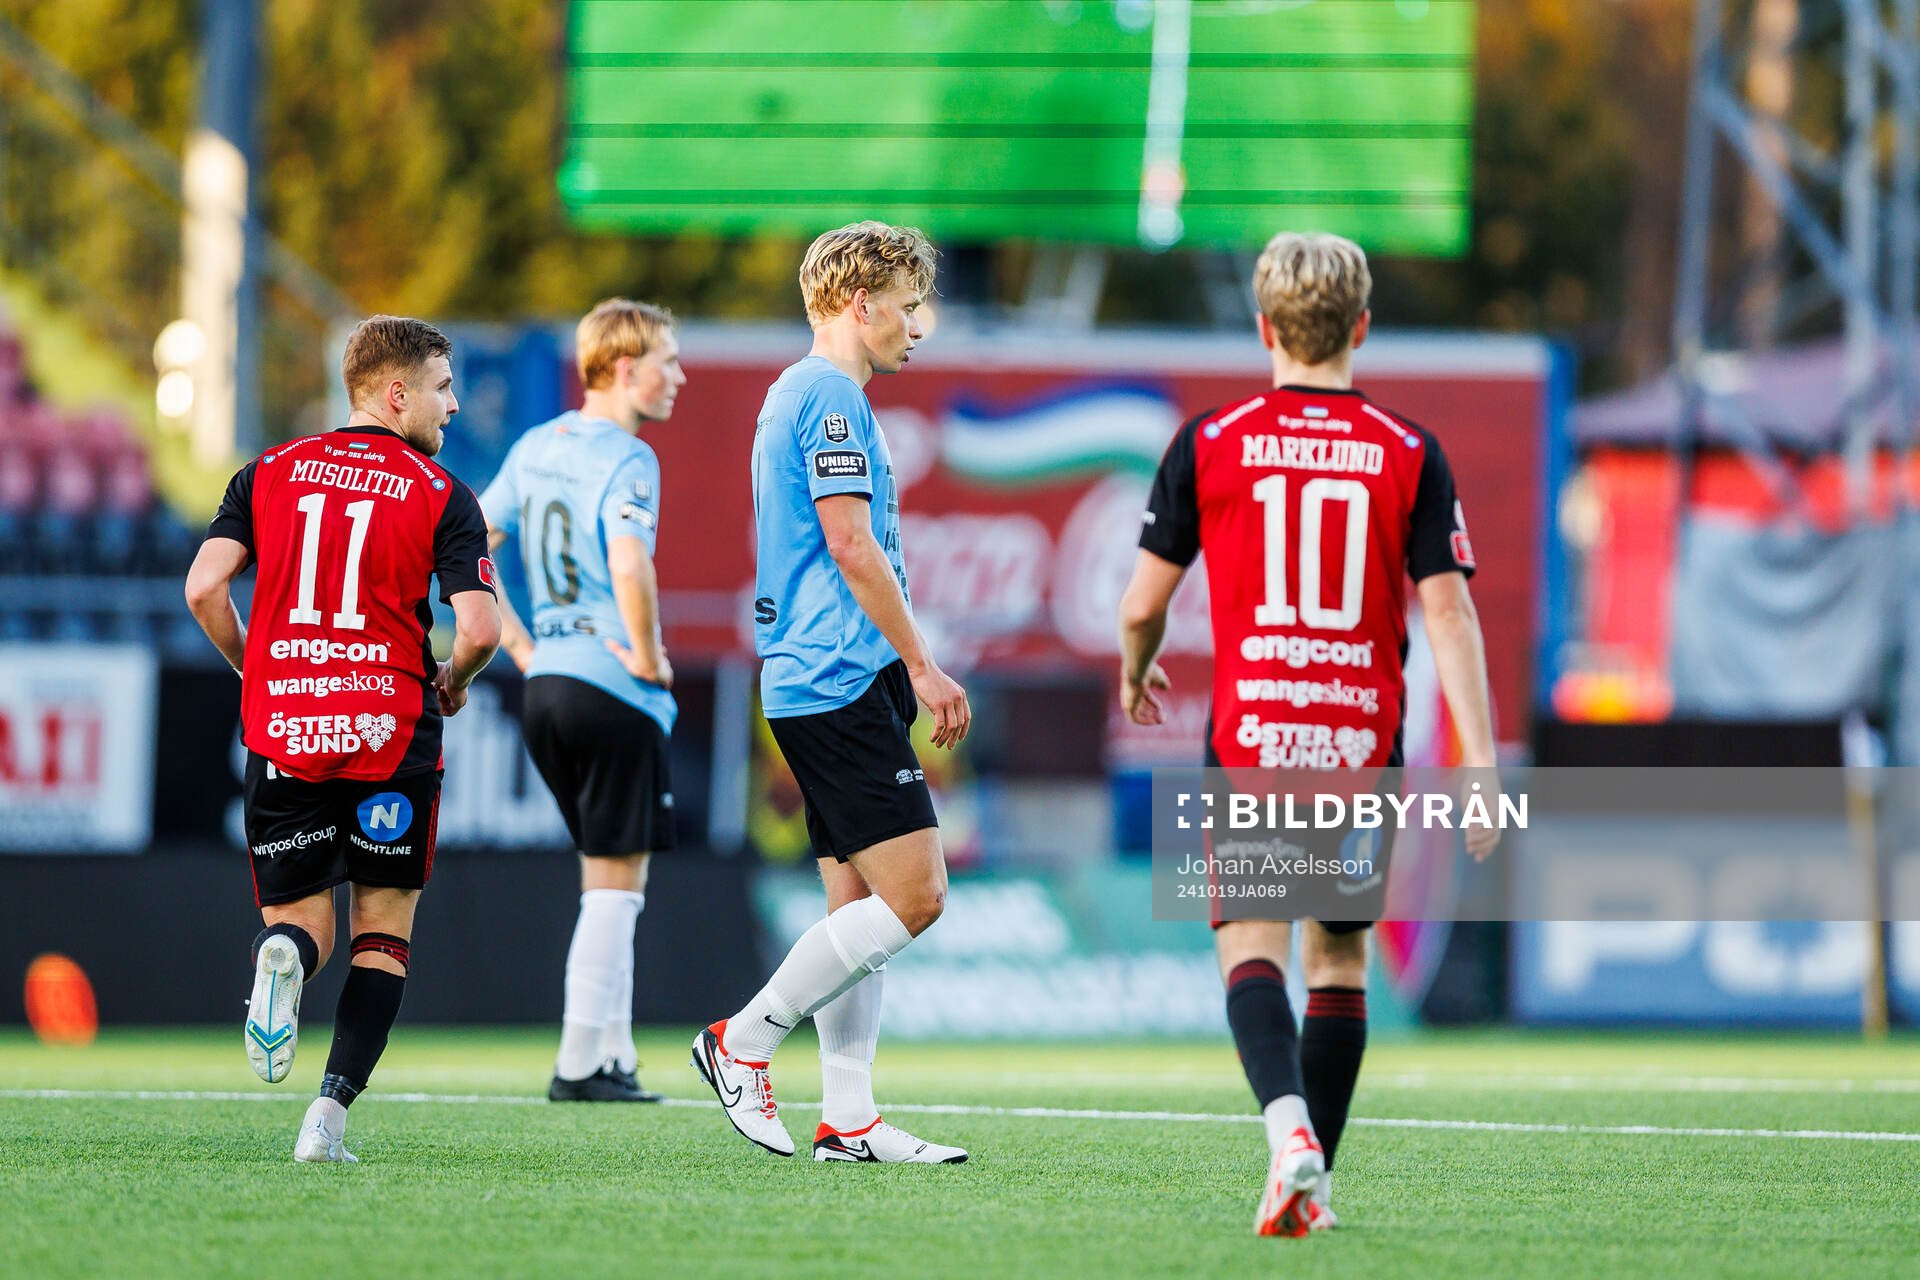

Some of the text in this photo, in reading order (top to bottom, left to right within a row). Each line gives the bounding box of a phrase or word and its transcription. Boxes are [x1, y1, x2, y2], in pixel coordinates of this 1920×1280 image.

[324, 444, 333, 453] Vi
[348, 451, 362, 459] oss
[363, 452, 386, 463] aldrig
[818, 455, 864, 468] UNIBET
[1240, 434, 1385, 476] MARKLUND
[289, 459, 415, 502] MUSOLITIN
[289, 493, 375, 631] 11
[522, 496, 580, 607] 10
[1252, 474, 1370, 631] 10
[270, 638, 389, 665] engcon
[1240, 636, 1372, 669] engcon
[267, 670, 396, 698] wangeskog
[1236, 678, 1380, 715] wangeskog
[267, 712, 352, 738] ÖSTER
[1236, 714, 1336, 749] ÖSTER
[286, 733, 361, 755] SUND
[1258, 744, 1341, 772] SUND
[369, 802, 400, 829] N
[350, 834, 412, 855] NIGHTLINE
